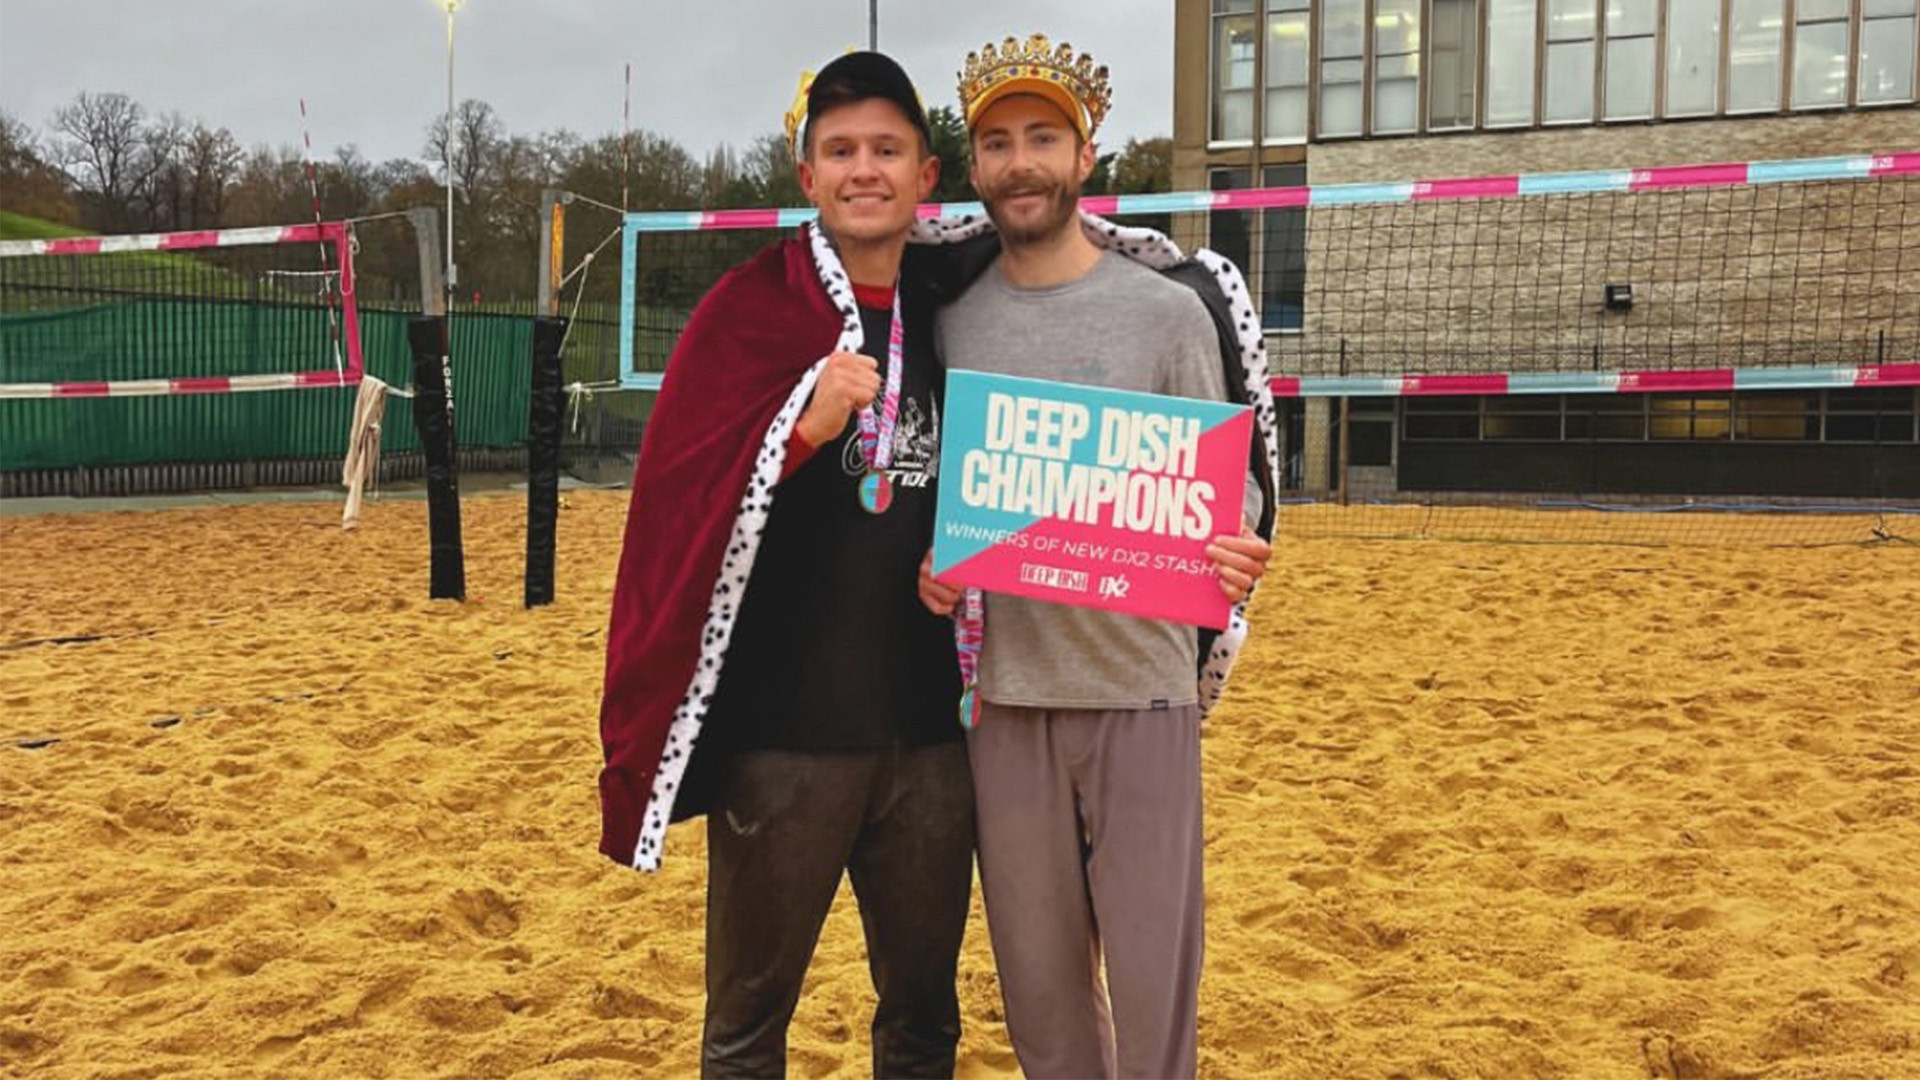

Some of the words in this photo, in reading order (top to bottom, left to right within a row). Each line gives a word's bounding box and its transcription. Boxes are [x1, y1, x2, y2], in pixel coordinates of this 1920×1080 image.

[442, 355, 454, 409] FORZA
[985, 392, 1090, 460] DEEP
[1097, 406, 1201, 478] DISH
[961, 448, 1216, 541] CHAMPIONS
[945, 521, 1030, 549] WINNERS
[1033, 536, 1060, 552] OF
[1062, 541, 1109, 559] NEW
[1112, 548, 1150, 568] DX2
